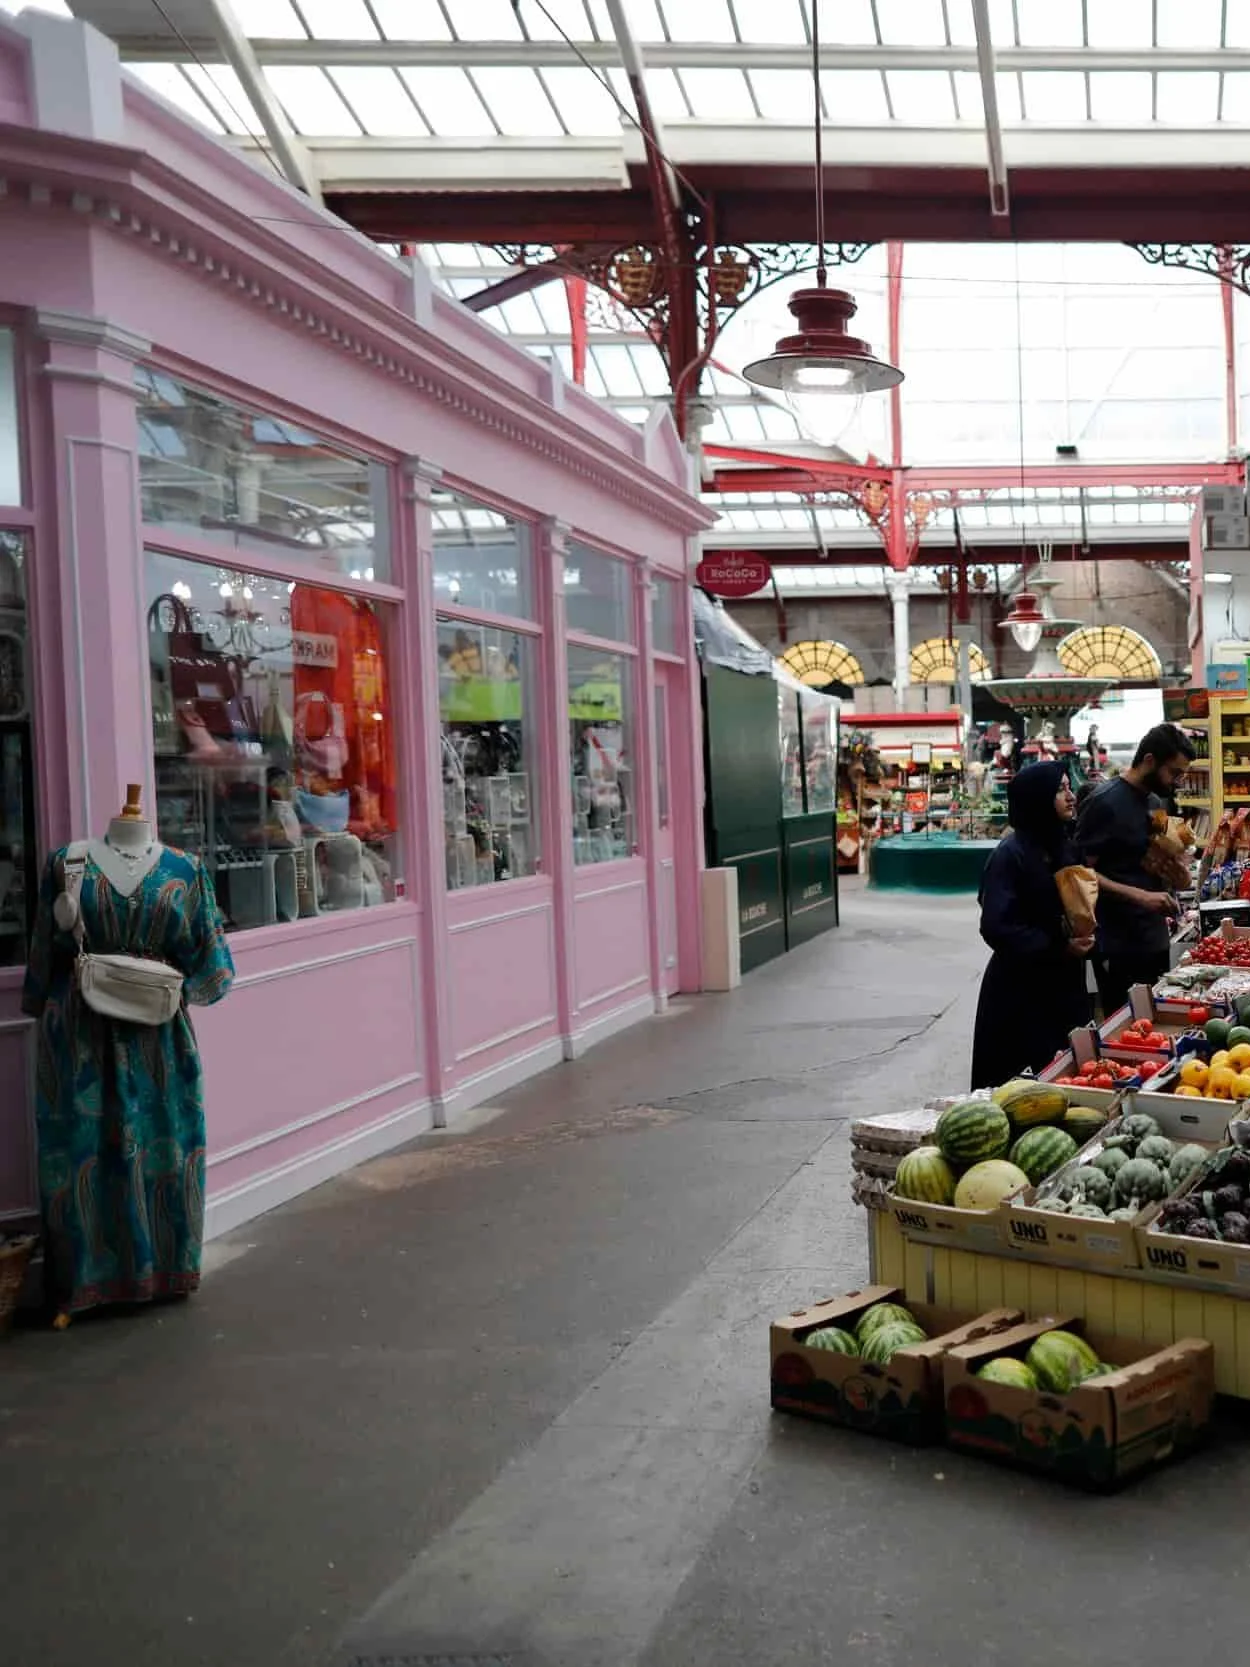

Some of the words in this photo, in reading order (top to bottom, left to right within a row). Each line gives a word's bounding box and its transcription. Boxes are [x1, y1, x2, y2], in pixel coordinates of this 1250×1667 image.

[895, 1209, 928, 1229] UNO
[1010, 1219, 1047, 1241] UNO
[1147, 1246, 1187, 1268] UNO
